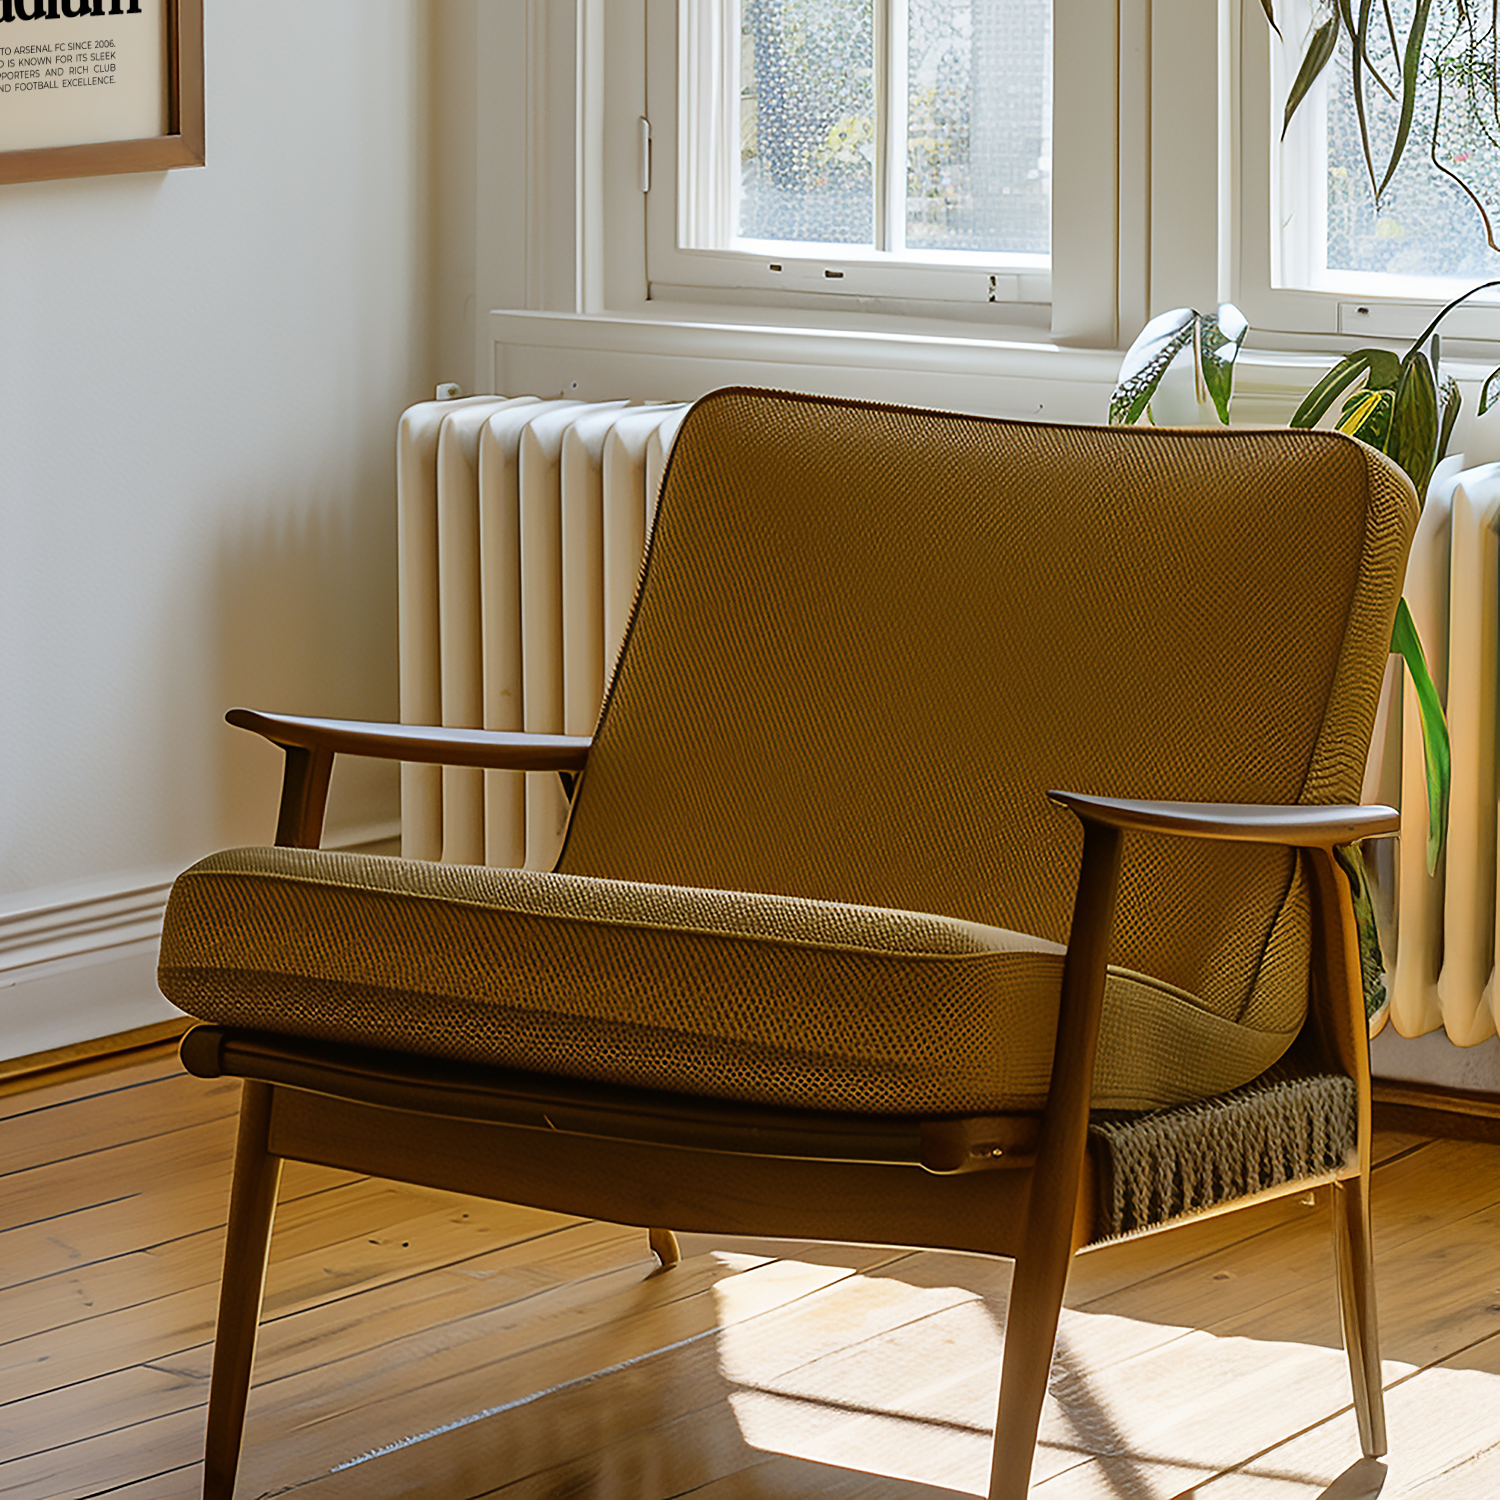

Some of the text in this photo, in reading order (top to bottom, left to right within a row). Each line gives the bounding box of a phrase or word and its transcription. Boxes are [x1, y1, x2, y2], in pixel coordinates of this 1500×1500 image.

[0, 47, 12, 56] TO
[13, 44, 53, 55] ARSENAL
[54, 43, 66, 52] FC
[67, 41, 93, 51] SINCE
[94, 39, 117, 49] 2006.
[7, 59, 16, 68] IS
[18, 57, 52, 68] KNOWN
[55, 55, 73, 65] FOR
[75, 53, 88, 63] ITS
[89, 52, 116, 62] SLEEK
[44, 68, 65, 78] AND
[68, 66, 89, 75] RICH
[93, 64, 117, 74] CLUB
[14, 80, 59, 92] FOOTBALL
[61, 75, 116, 88] EXCELLENCE.
